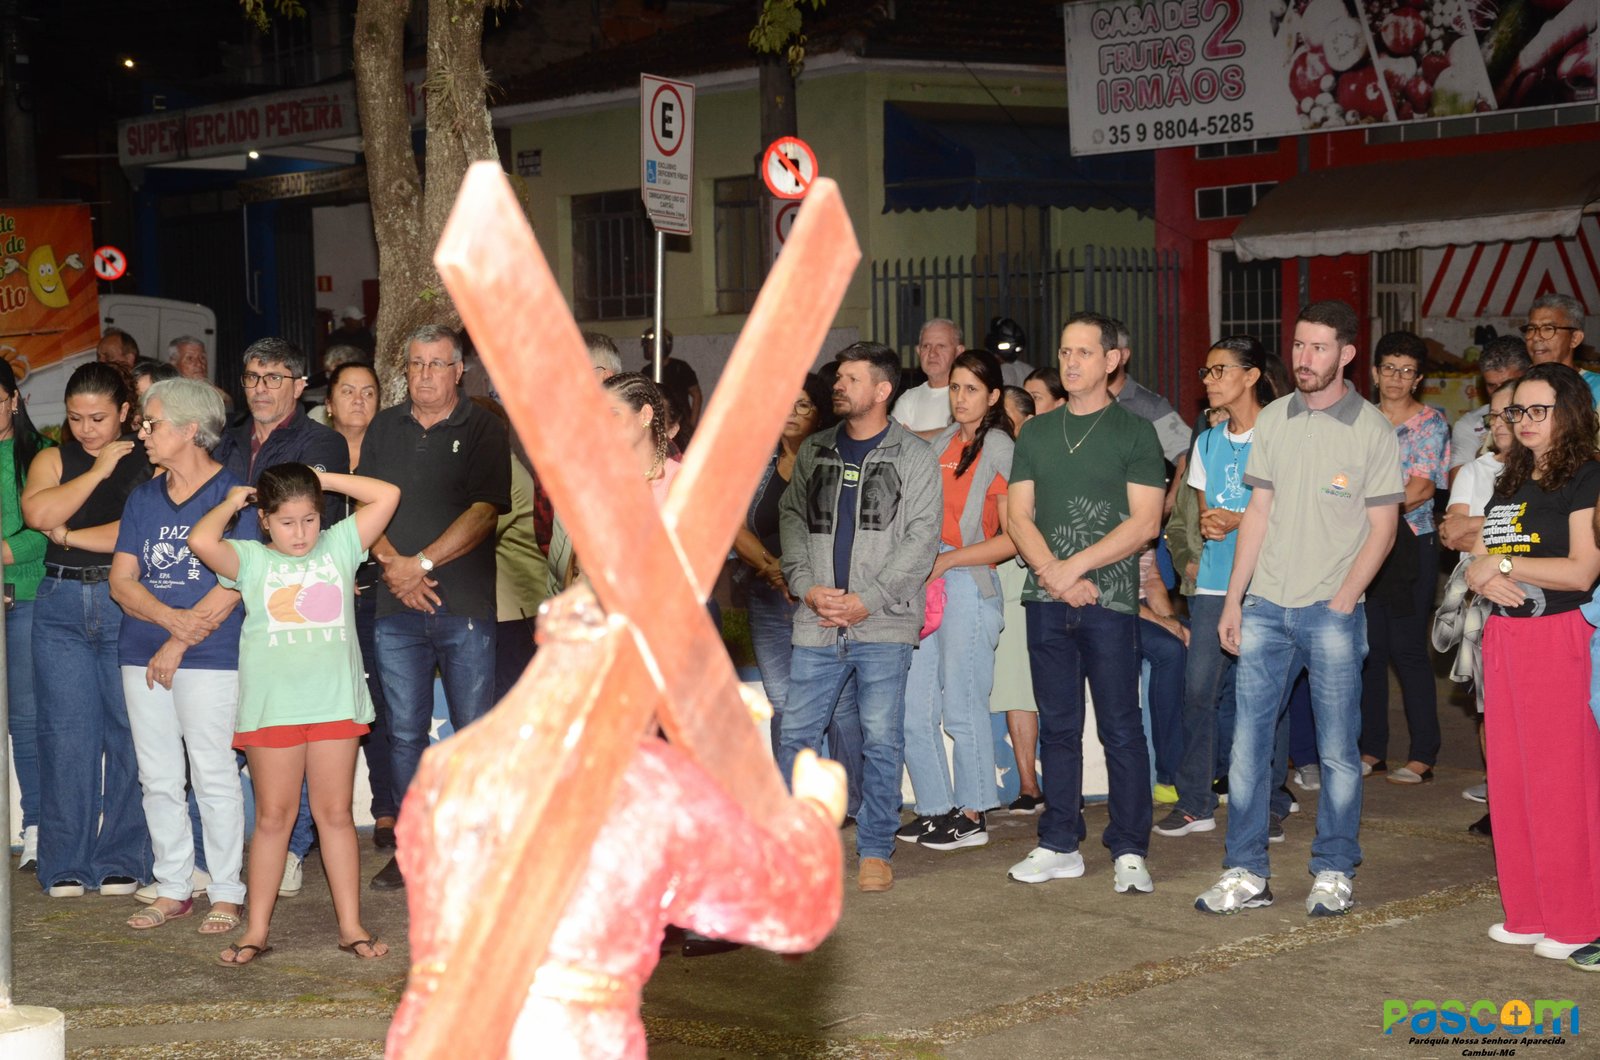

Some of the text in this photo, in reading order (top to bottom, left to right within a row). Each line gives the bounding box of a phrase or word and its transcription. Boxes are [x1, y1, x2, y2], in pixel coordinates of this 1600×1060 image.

[1092, 0, 1199, 39] CASA DE
[1099, 0, 1246, 75] FRUTAS 2
[1097, 65, 1246, 114] IRMÃOS
[265, 94, 344, 137] PEREIRA
[661, 101, 674, 139] E
[1109, 112, 1254, 144] 35 9 8804-5285
[6, 235, 25, 254] de
[159, 525, 190, 540] PAZ
[1513, 544, 1530, 553] em
[268, 626, 346, 647] ALIVE
